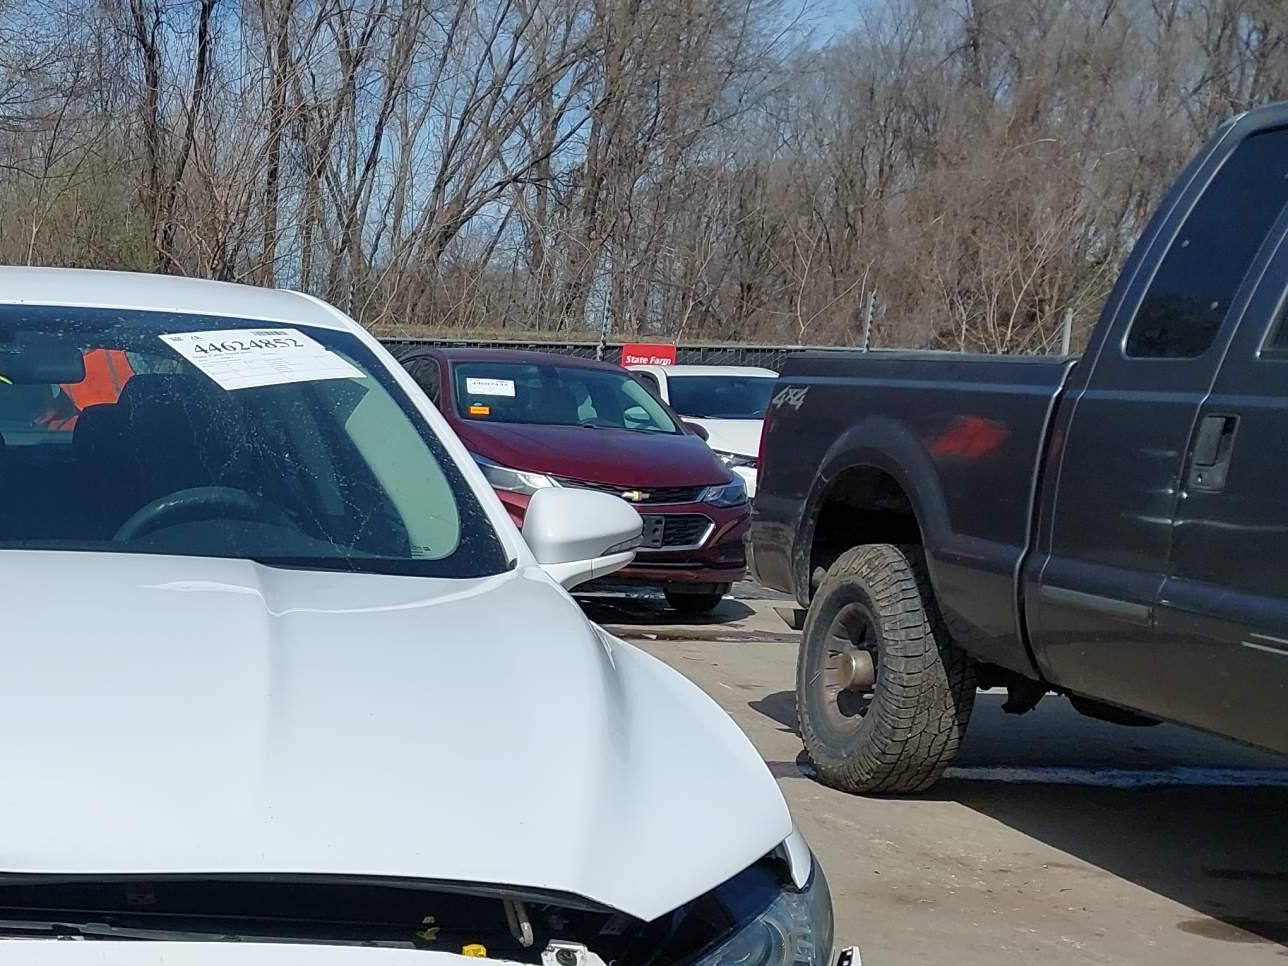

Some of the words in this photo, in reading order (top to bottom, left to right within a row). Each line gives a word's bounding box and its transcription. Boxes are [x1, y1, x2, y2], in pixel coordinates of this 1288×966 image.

[194, 338, 305, 354] 44624852
[625, 355, 649, 364] State
[649, 355, 672, 365] Farm
